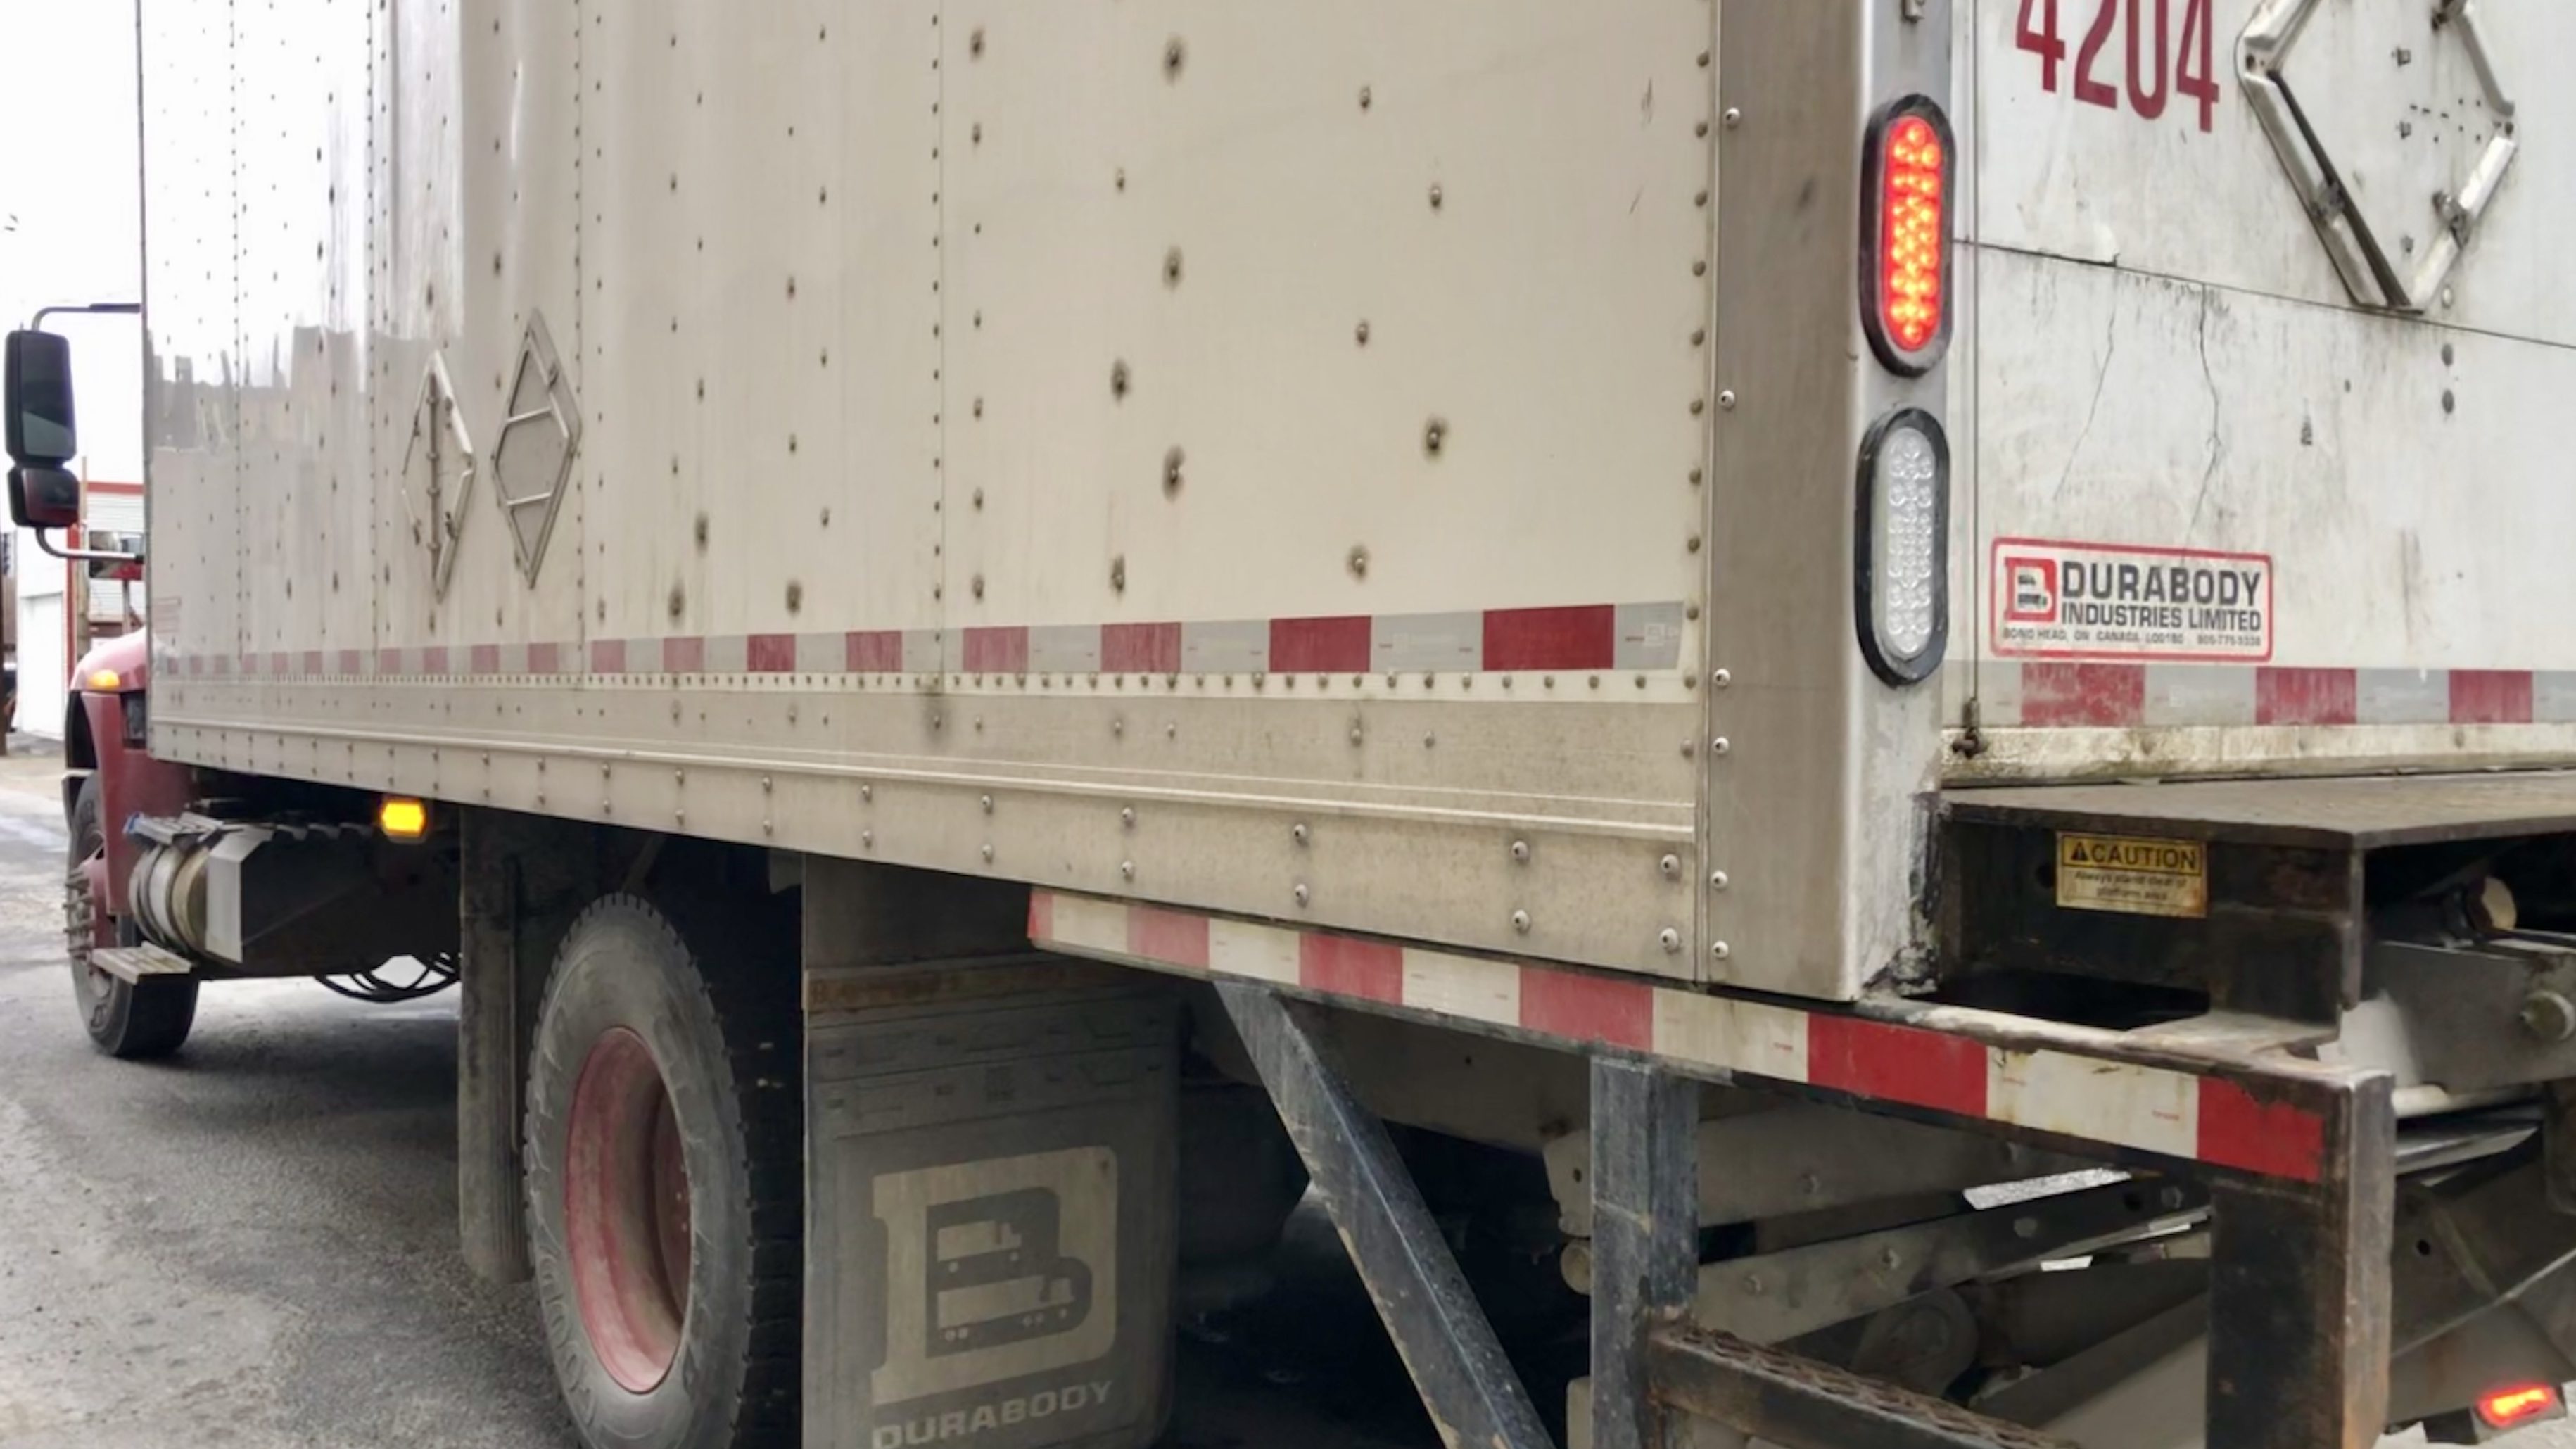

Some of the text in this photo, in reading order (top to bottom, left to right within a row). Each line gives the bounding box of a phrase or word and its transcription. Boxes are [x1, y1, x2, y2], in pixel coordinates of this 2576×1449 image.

[2015, 0, 2219, 132] 4204
[2062, 561, 2261, 606] DURABODY
[2062, 602, 2261, 631] INDUSTRIES LIMITED
[2091, 844, 2196, 870] CAUTION
[872, 1380, 1112, 1449] DURABODY
